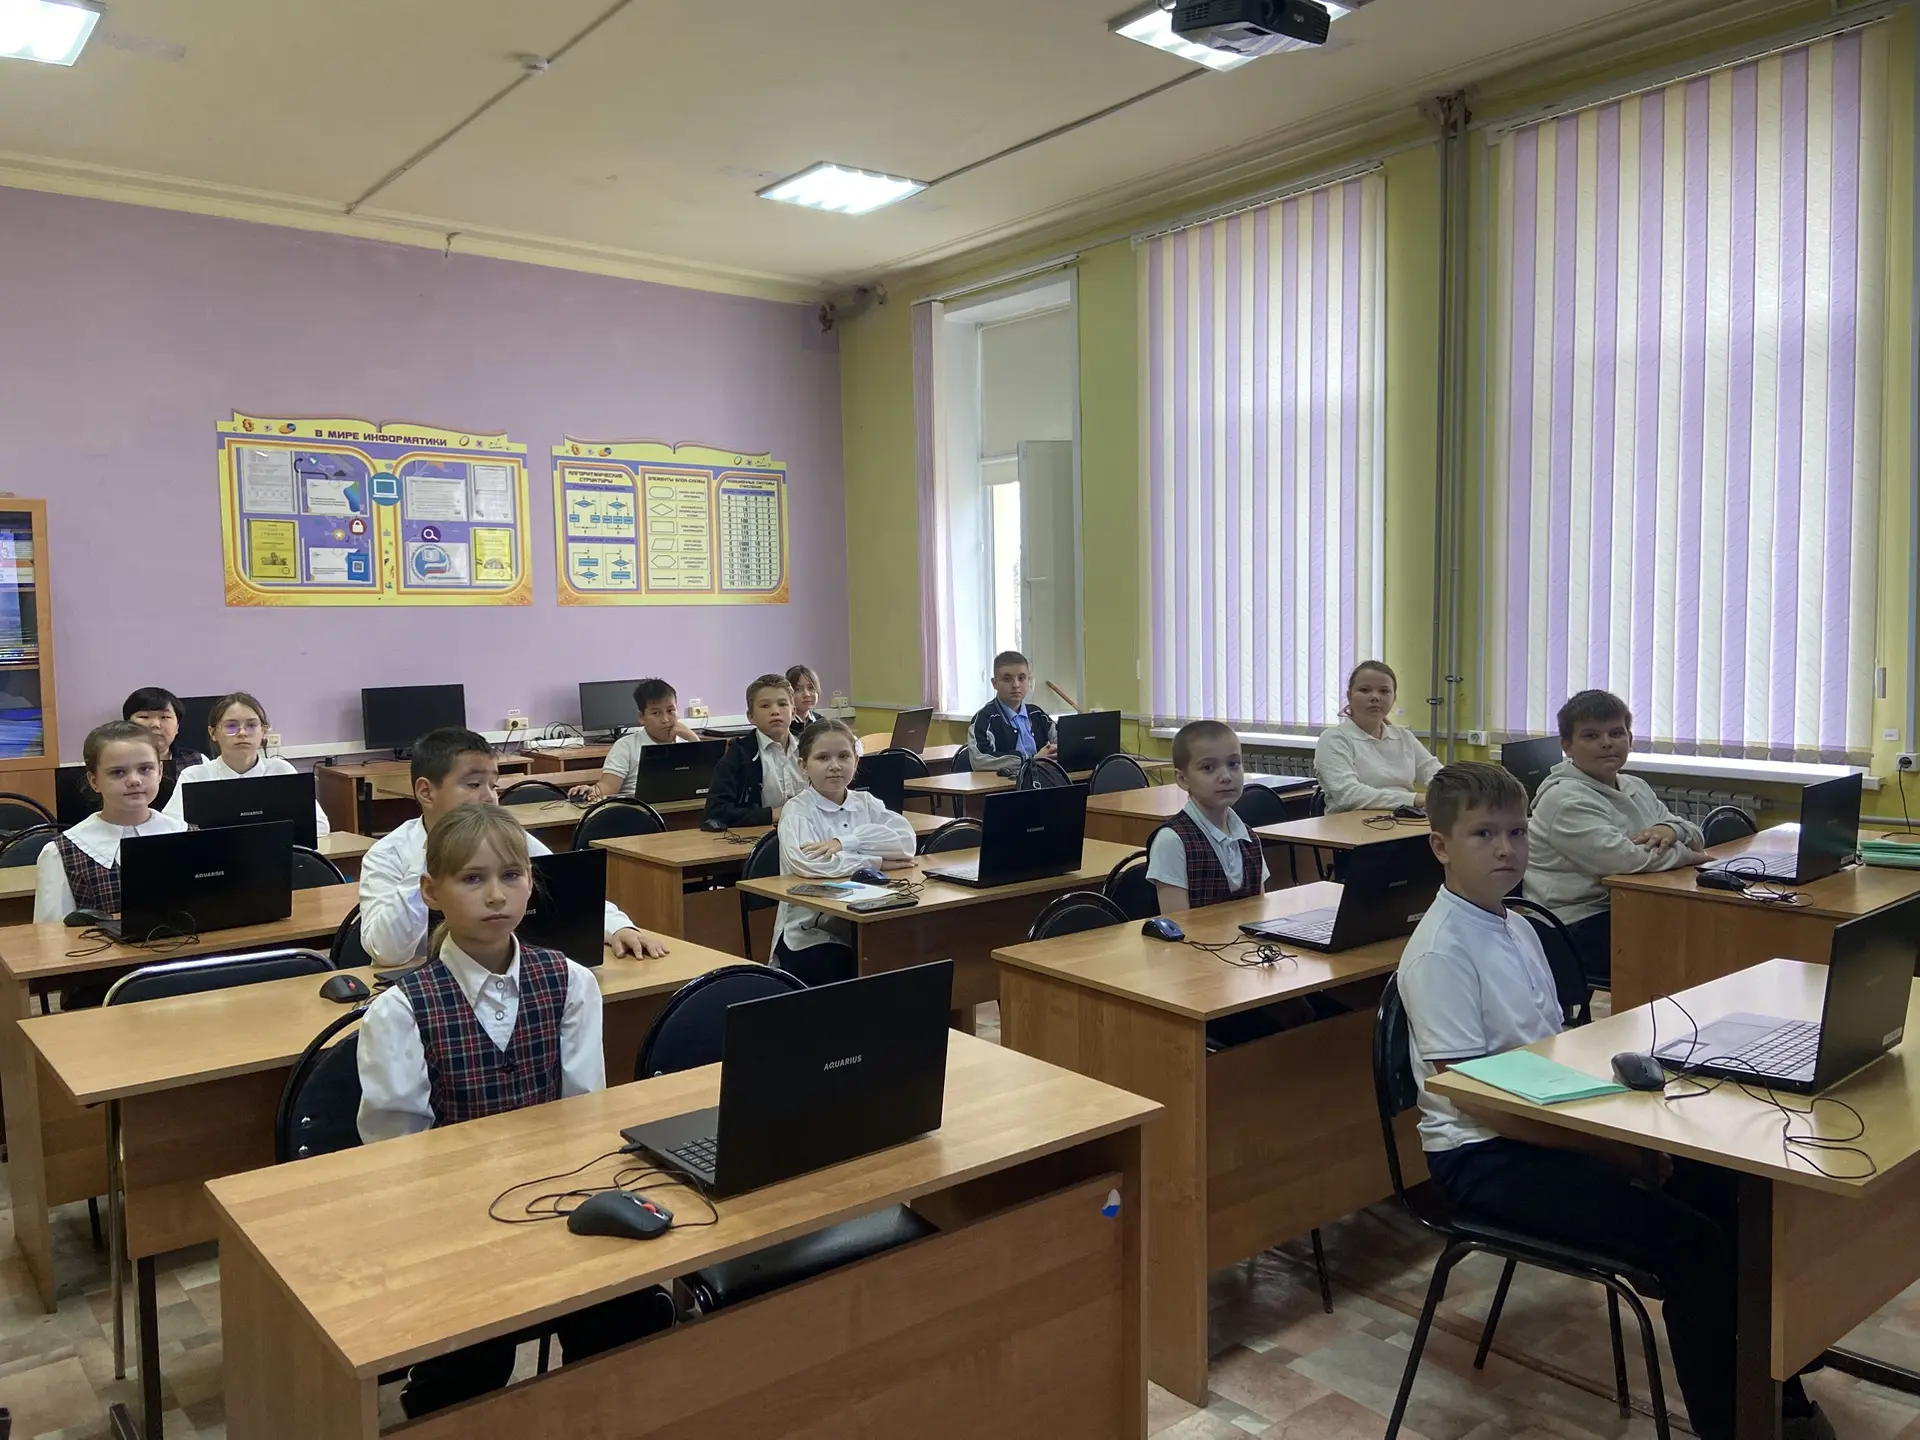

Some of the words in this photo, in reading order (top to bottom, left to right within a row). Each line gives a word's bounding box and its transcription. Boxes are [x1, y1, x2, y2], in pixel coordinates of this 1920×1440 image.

[328, 430, 360, 440] МИРЕ
[364, 433, 447, 446] ИНФОРМАТИКИ
[194, 870, 224, 878] AQUARIUS
[824, 1054, 862, 1071] AQUARIUS
